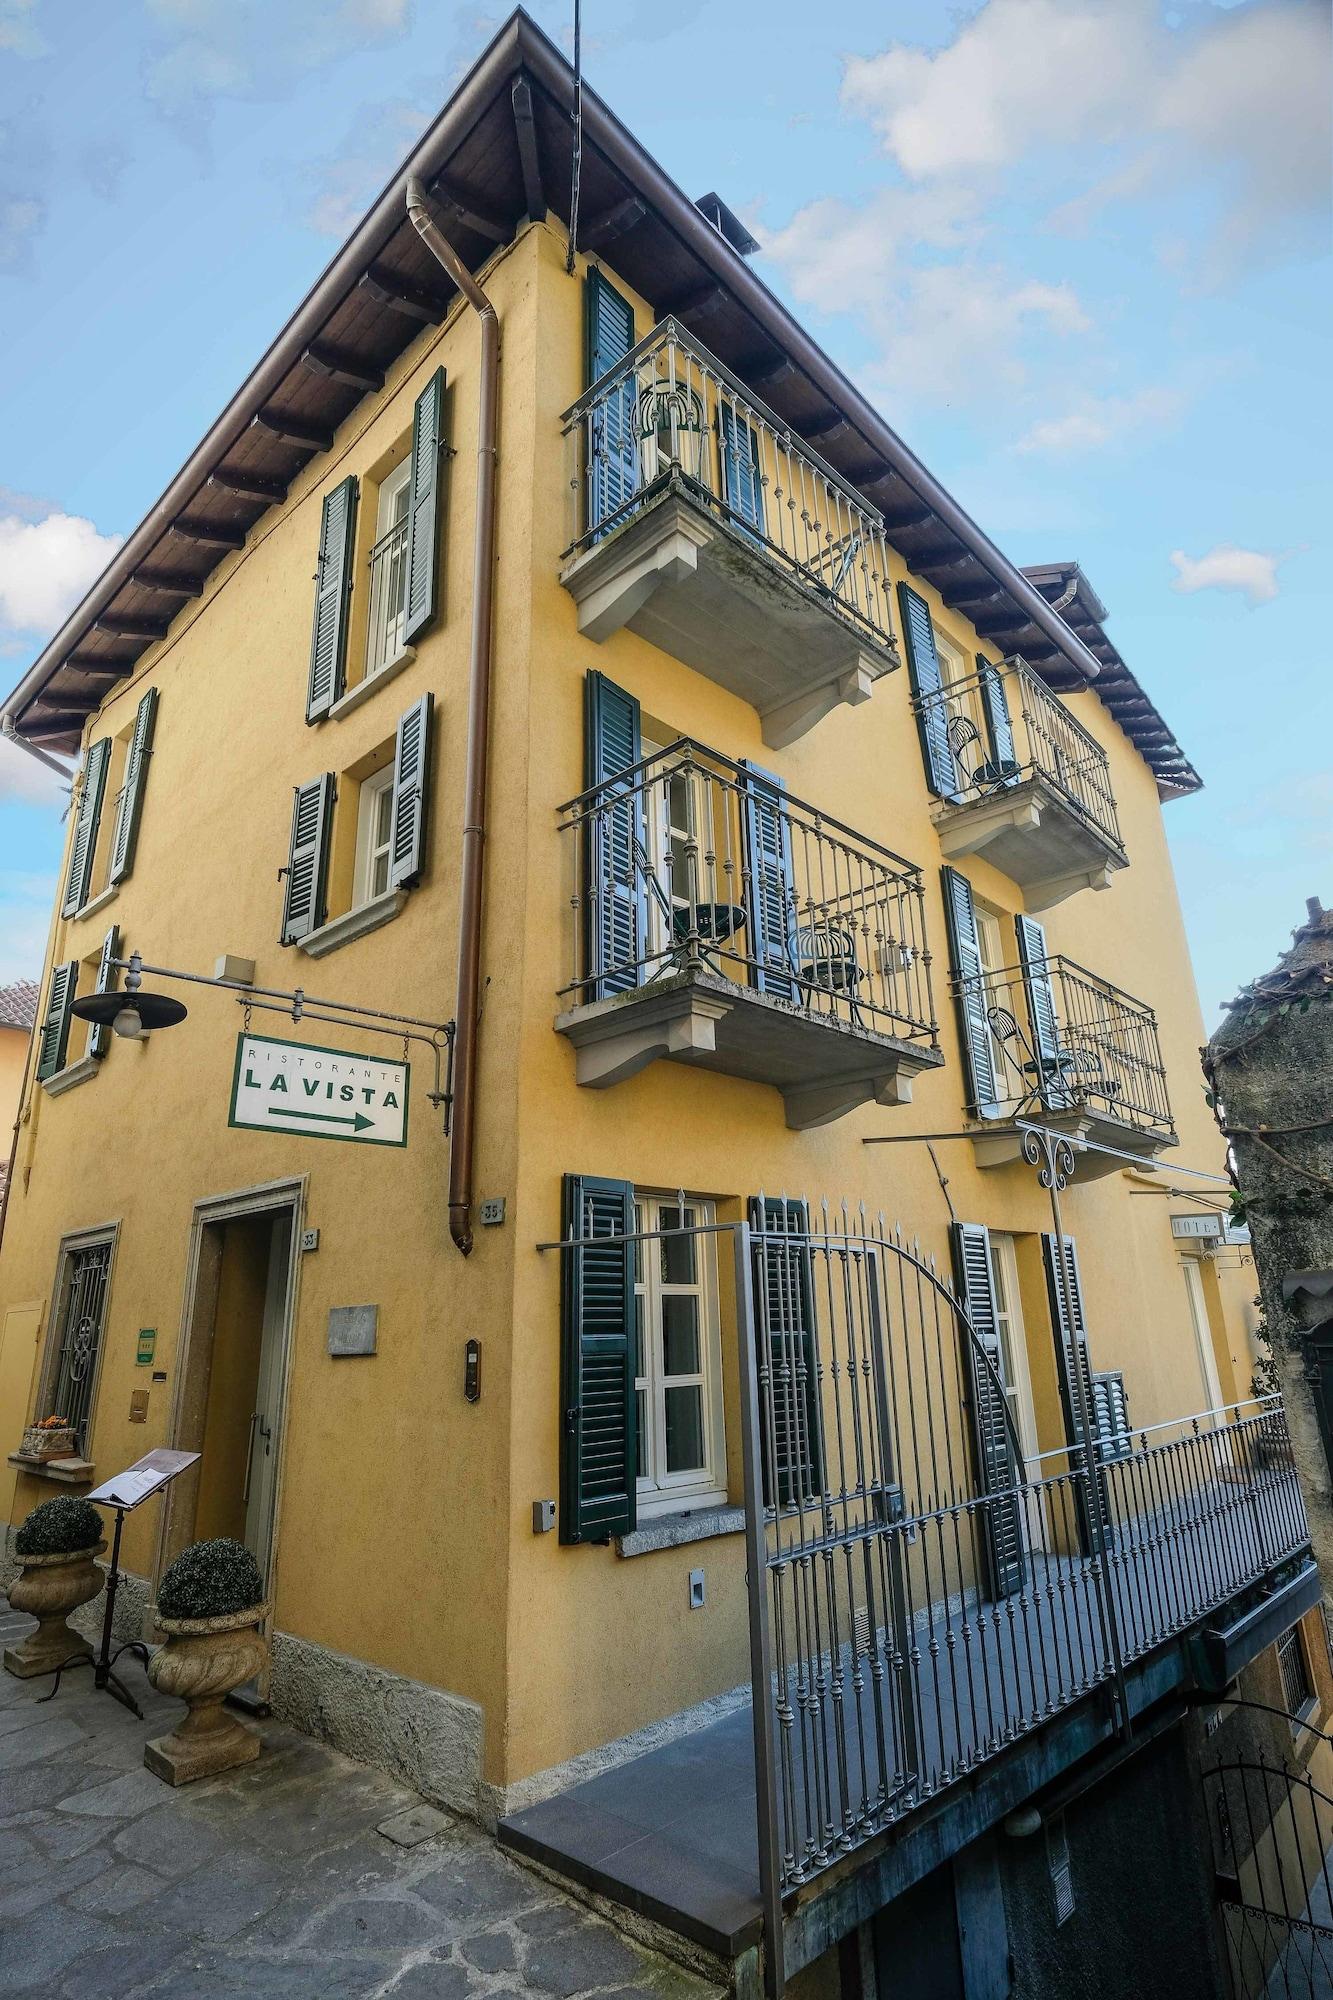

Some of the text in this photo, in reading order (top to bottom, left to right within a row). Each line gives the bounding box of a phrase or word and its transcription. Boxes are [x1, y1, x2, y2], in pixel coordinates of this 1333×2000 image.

[248, 1049, 401, 1083] RISTORANTE
[245, 1069, 399, 1108] LA VISTA
[1174, 1220, 1217, 1233] HOTE
